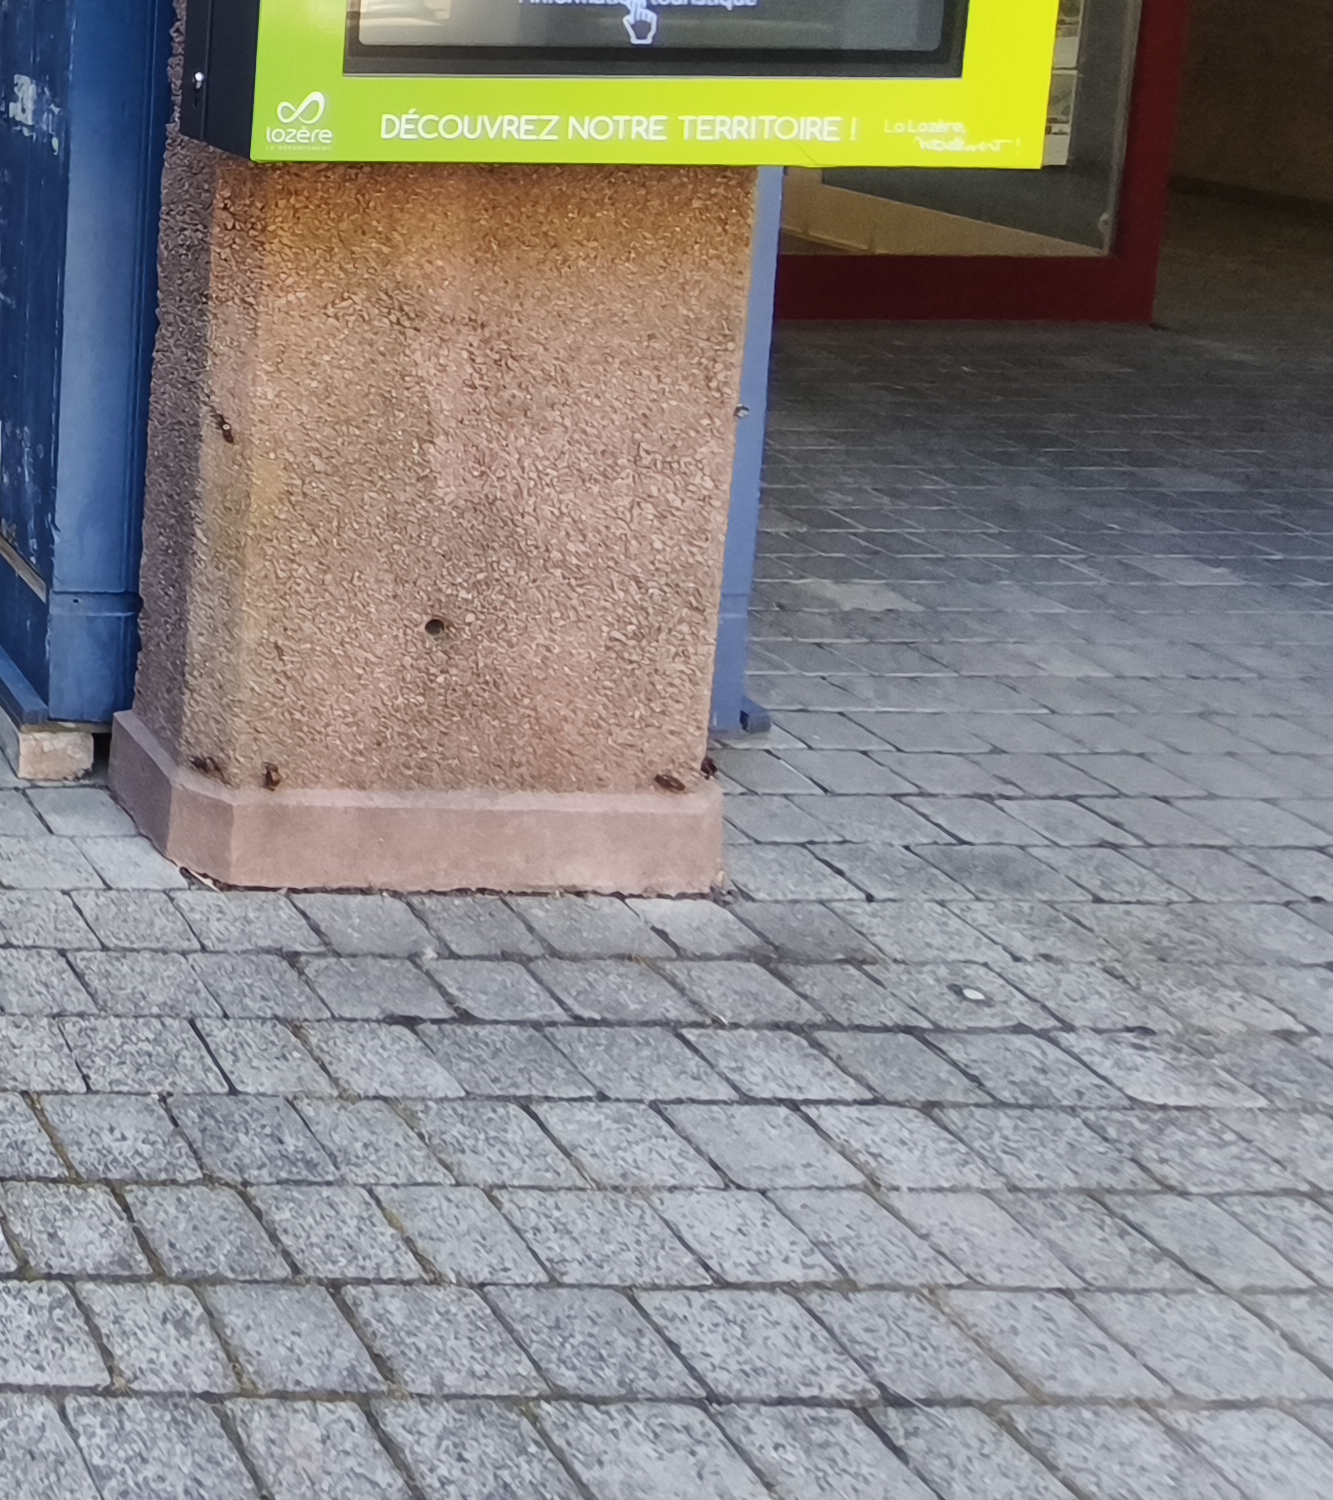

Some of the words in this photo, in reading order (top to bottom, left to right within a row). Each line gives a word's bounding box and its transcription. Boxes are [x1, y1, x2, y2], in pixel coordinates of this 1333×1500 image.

[265, 126, 333, 144] lozère
[381, 108, 560, 141] DÉCOUVREZ
[567, 115, 668, 141] NOTRE
[678, 115, 843, 142] TERRITOIRE
